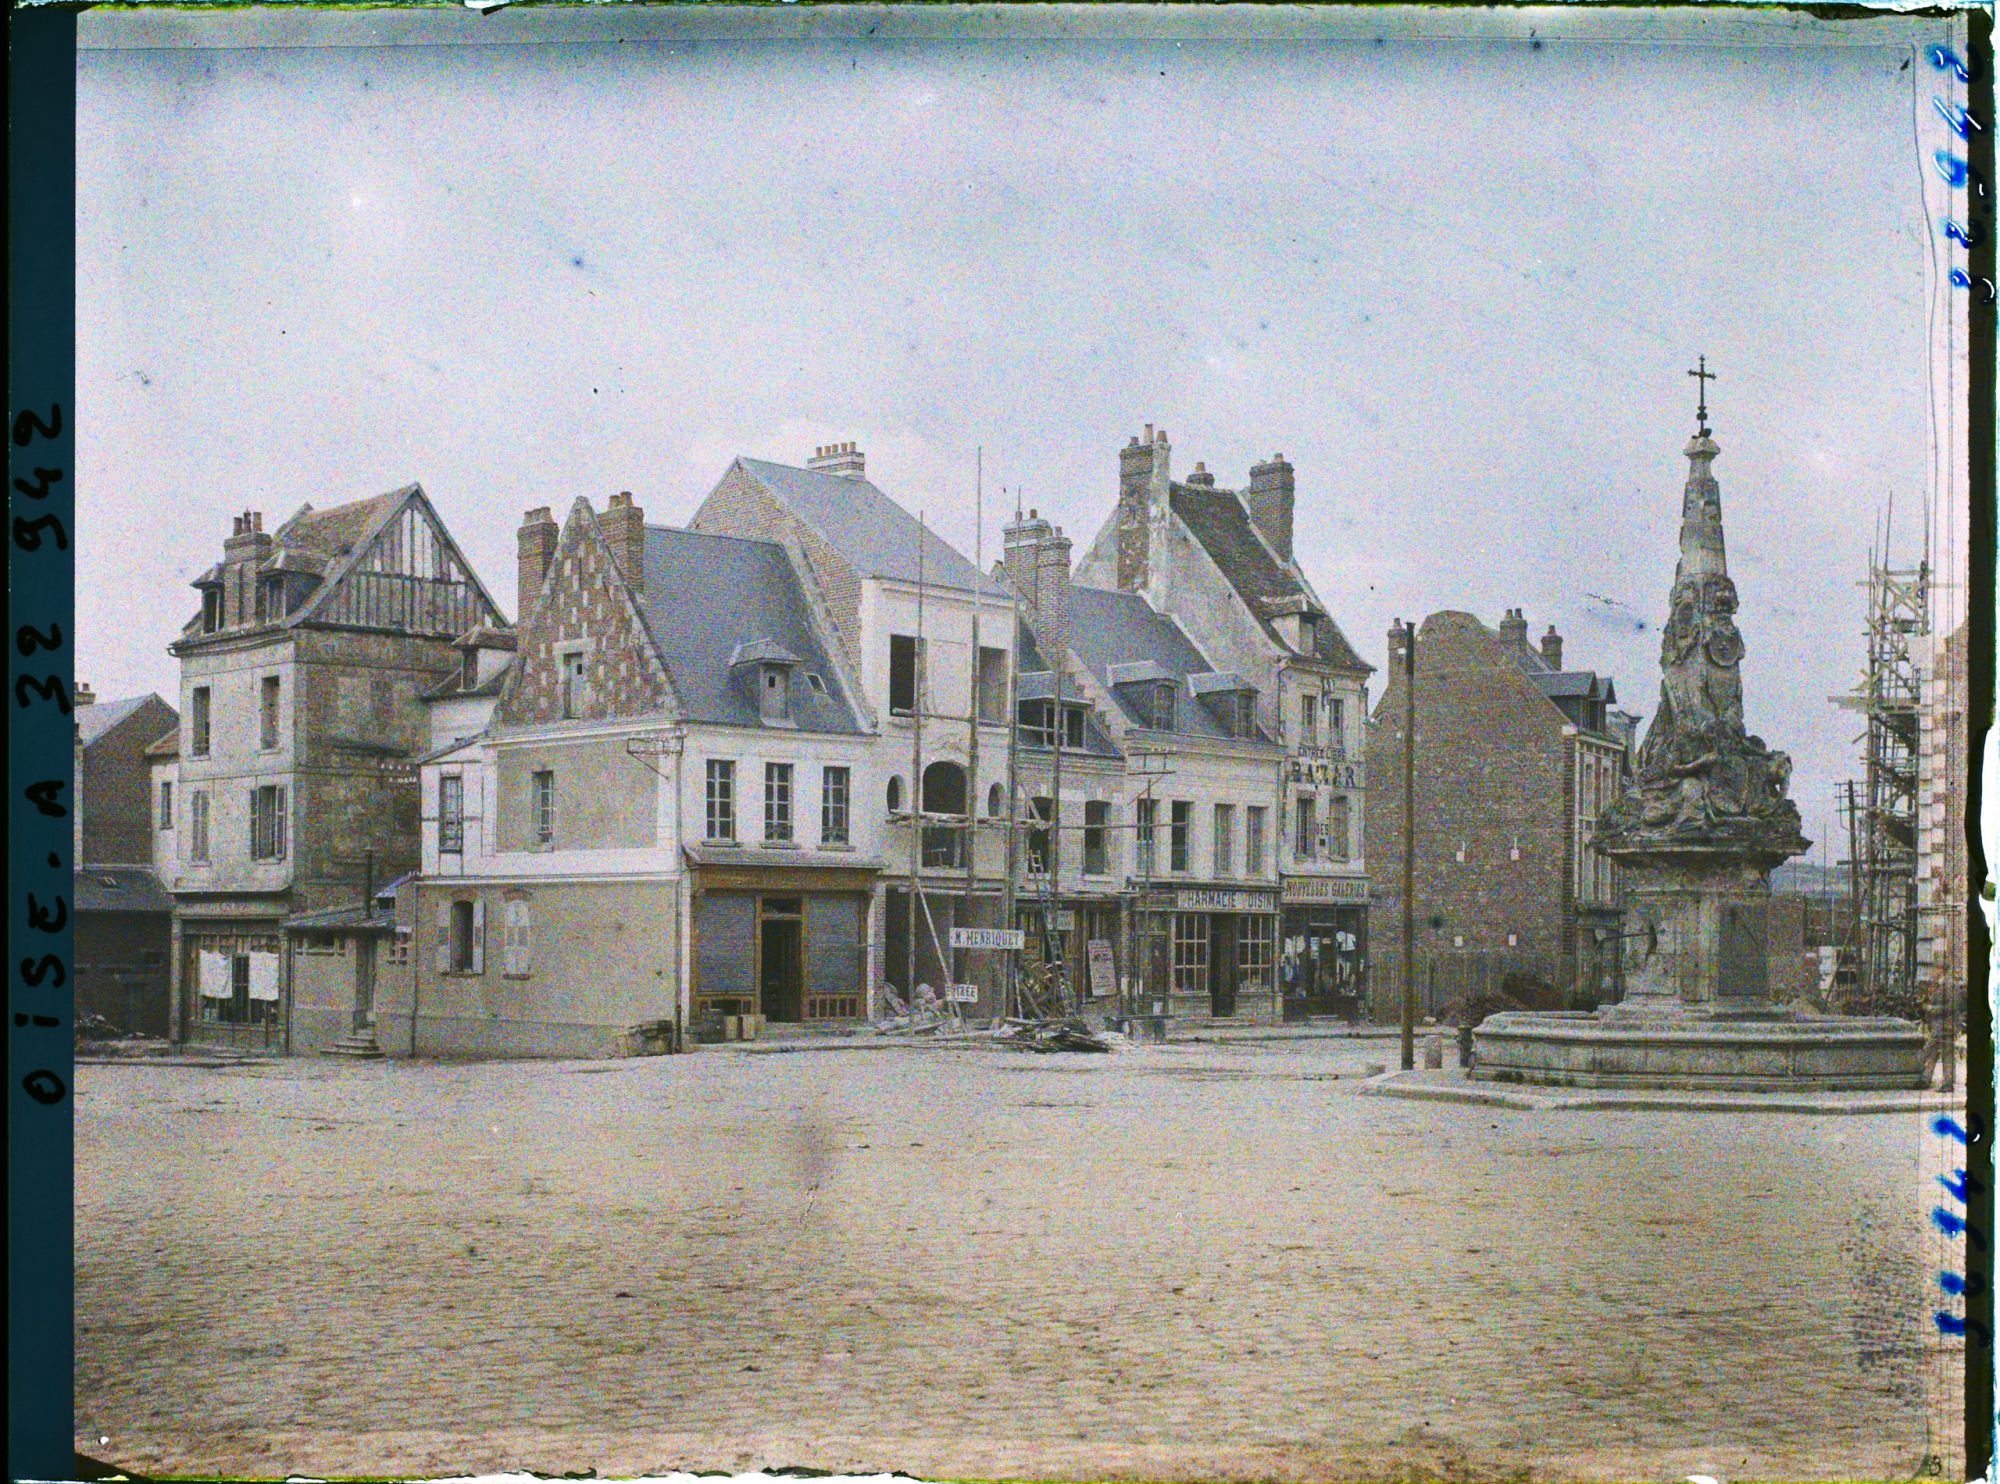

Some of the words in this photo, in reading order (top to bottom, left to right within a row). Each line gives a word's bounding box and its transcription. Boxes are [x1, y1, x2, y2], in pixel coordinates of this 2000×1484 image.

[1286, 882, 1328, 898] NOUVELLES
[1331, 883, 1365, 898] GALERIES
[1180, 890, 1236, 908] HARMACIE
[966, 931, 1020, 946] HENRIQUET
